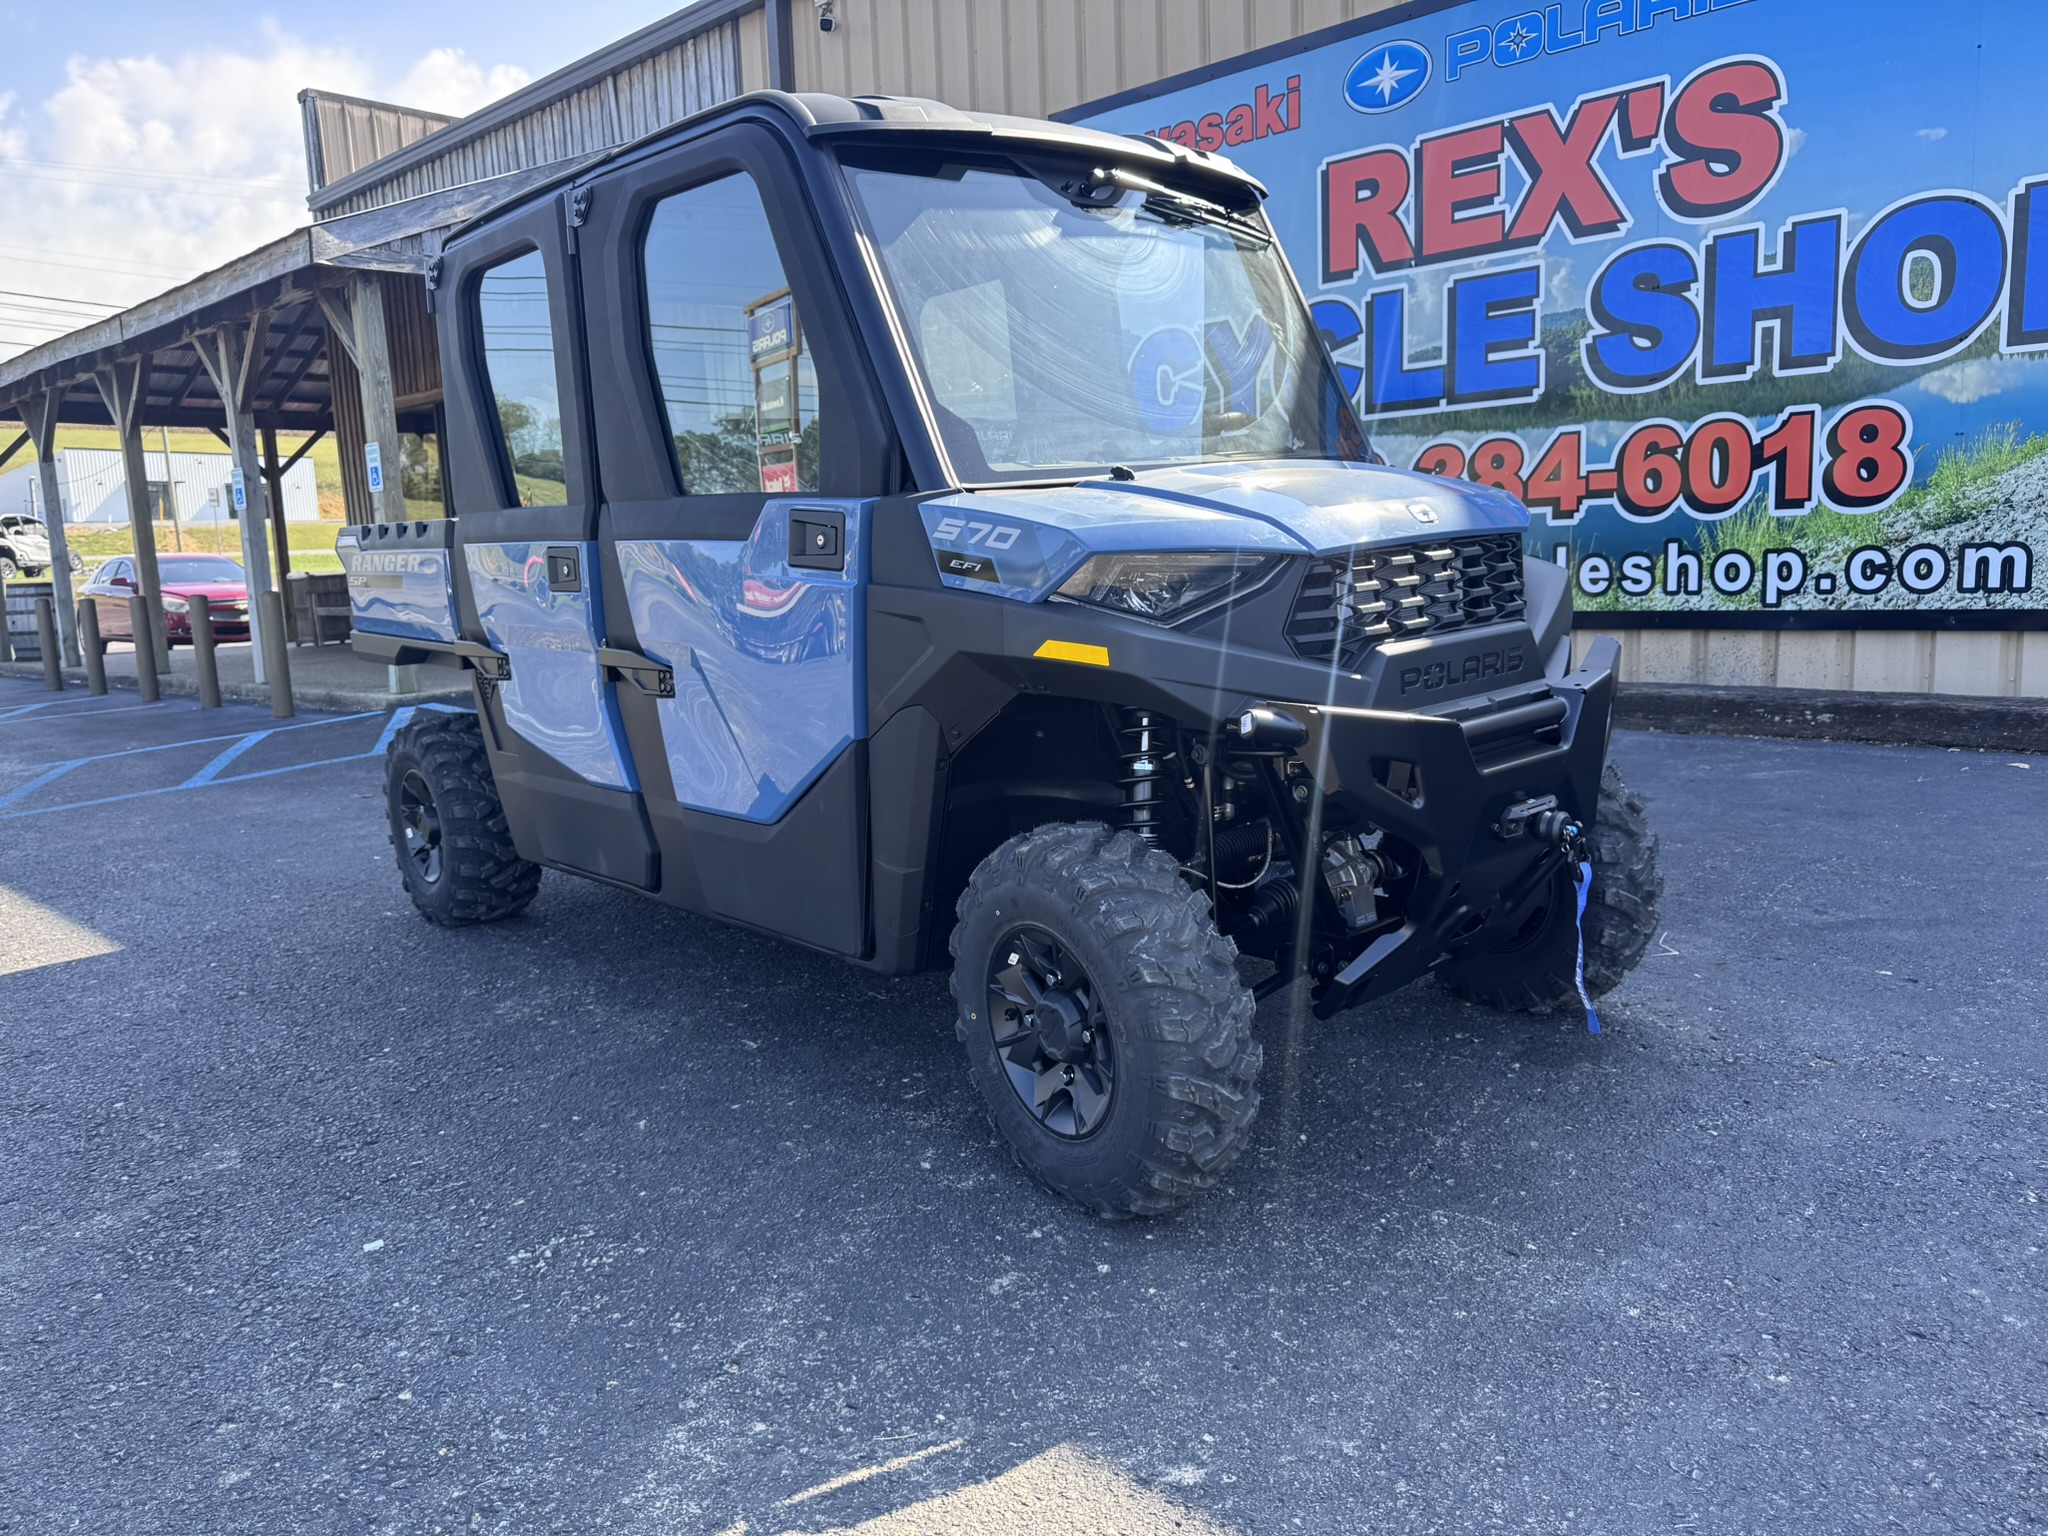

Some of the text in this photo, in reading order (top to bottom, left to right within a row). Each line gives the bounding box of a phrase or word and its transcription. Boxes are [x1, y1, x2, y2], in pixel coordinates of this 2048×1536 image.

[1320, 57, 1786, 278] REX'S
[933, 517, 1022, 550] 570
[352, 554, 420, 573] RANGER
[950, 559, 982, 572] EFI
[349, 576, 367, 586] SP
[1400, 646, 1524, 696] POLARIS
